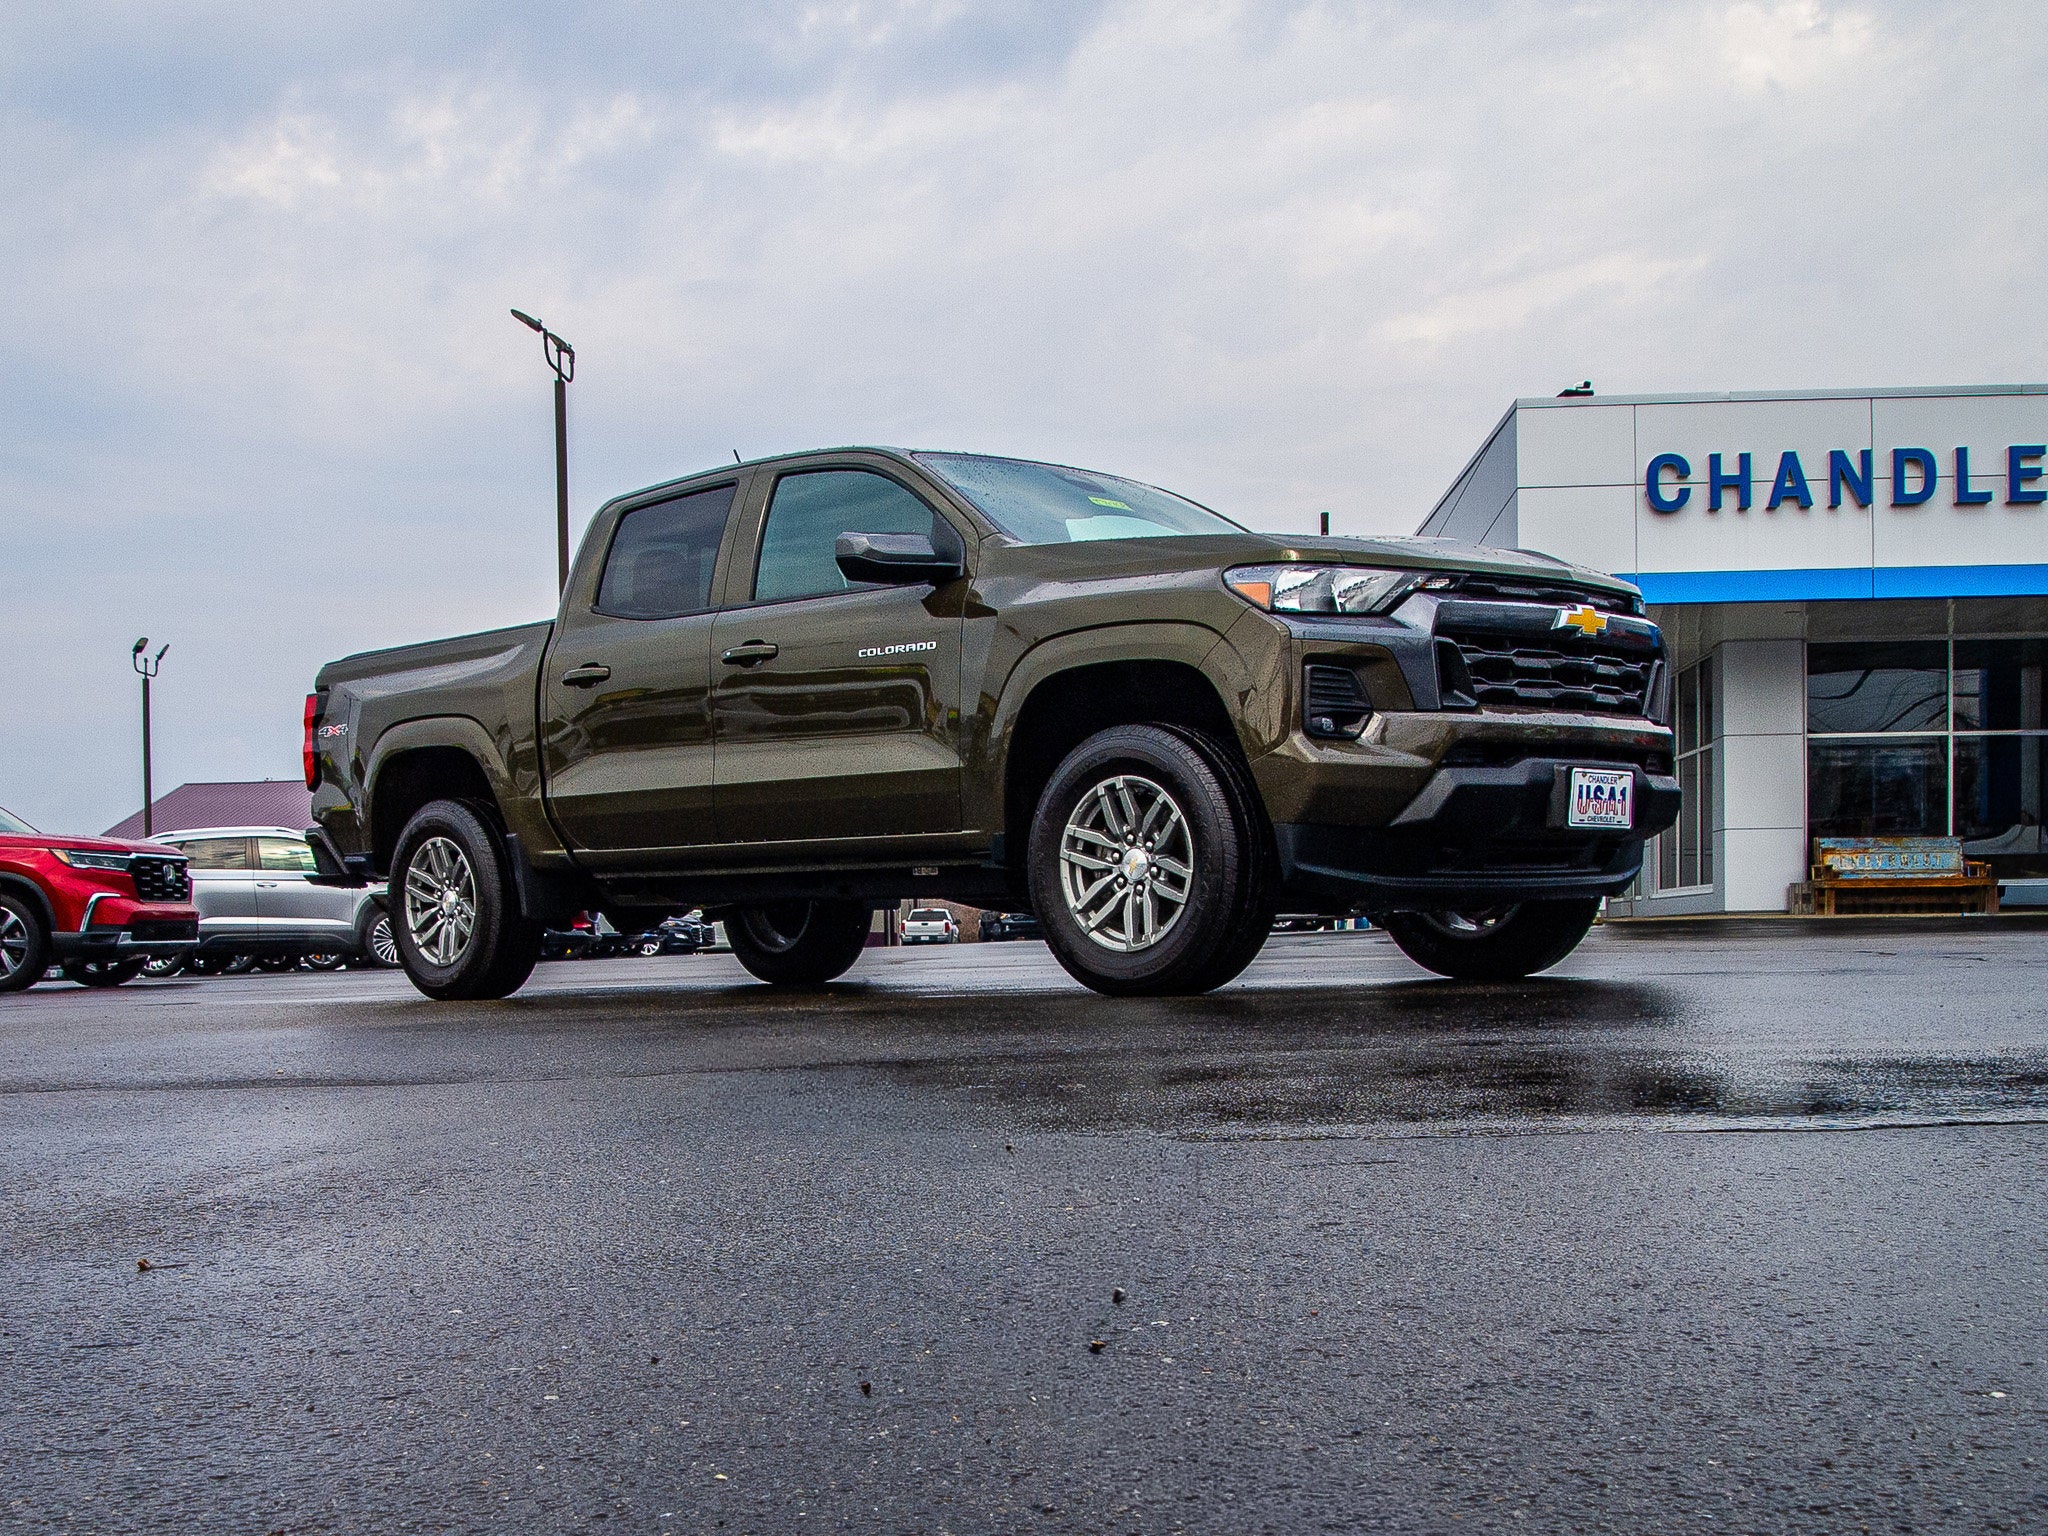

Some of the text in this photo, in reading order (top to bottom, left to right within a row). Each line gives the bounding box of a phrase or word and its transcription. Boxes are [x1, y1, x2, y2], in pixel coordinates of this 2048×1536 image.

[1645, 445, 2047, 512] CHANDLE
[858, 641, 937, 657] COLORADO
[1588, 775, 1618, 785] CHANDLER
[1587, 815, 1616, 823] CHEVROLET
